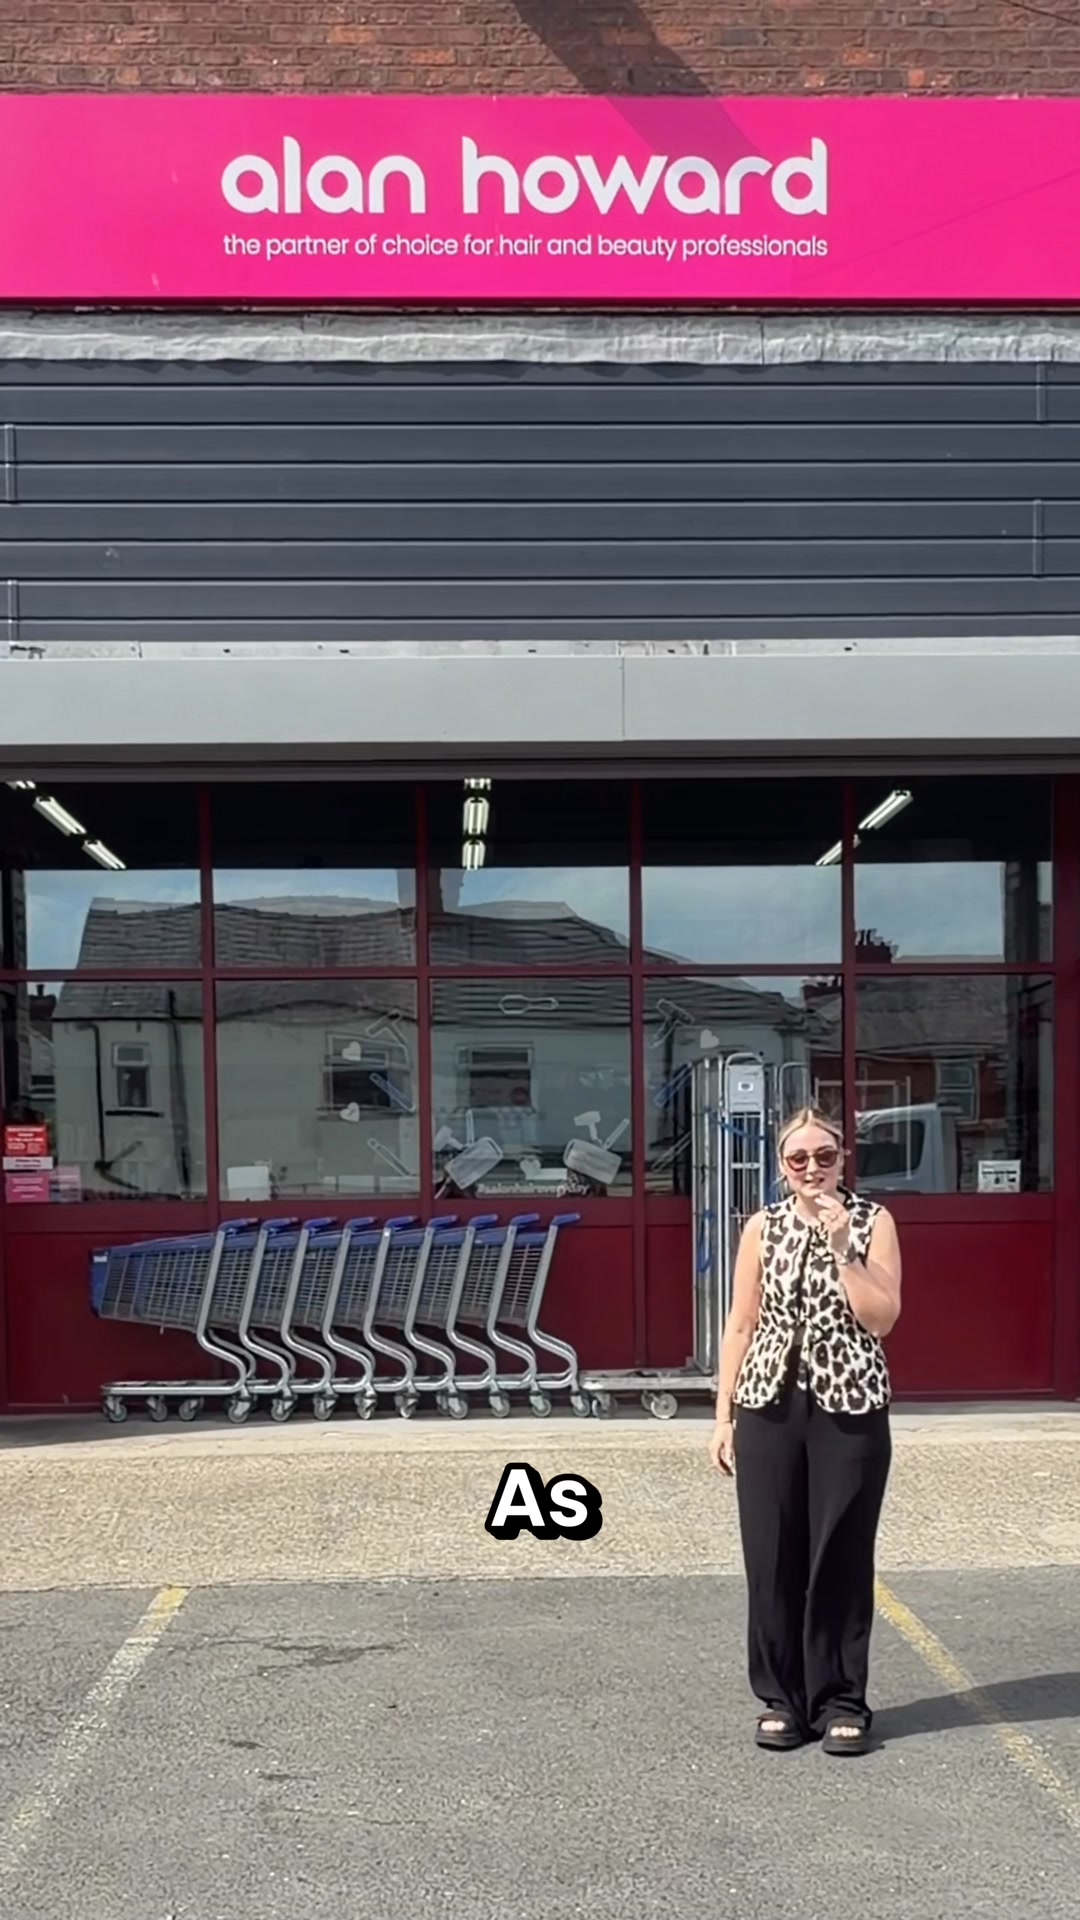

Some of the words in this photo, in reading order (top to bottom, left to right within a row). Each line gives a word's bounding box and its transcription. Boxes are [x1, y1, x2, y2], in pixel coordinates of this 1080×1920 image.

[221, 135, 426, 214] alan
[462, 135, 828, 215] howard
[223, 234, 261, 255] the
[266, 234, 349, 260] partner
[355, 233, 377, 255] of
[382, 233, 458, 255] choice
[463, 233, 494, 255] for
[499, 233, 542, 255] hair
[547, 234, 592, 256] and
[597, 234, 677, 261] beauty
[682, 234, 828, 261] professionals
